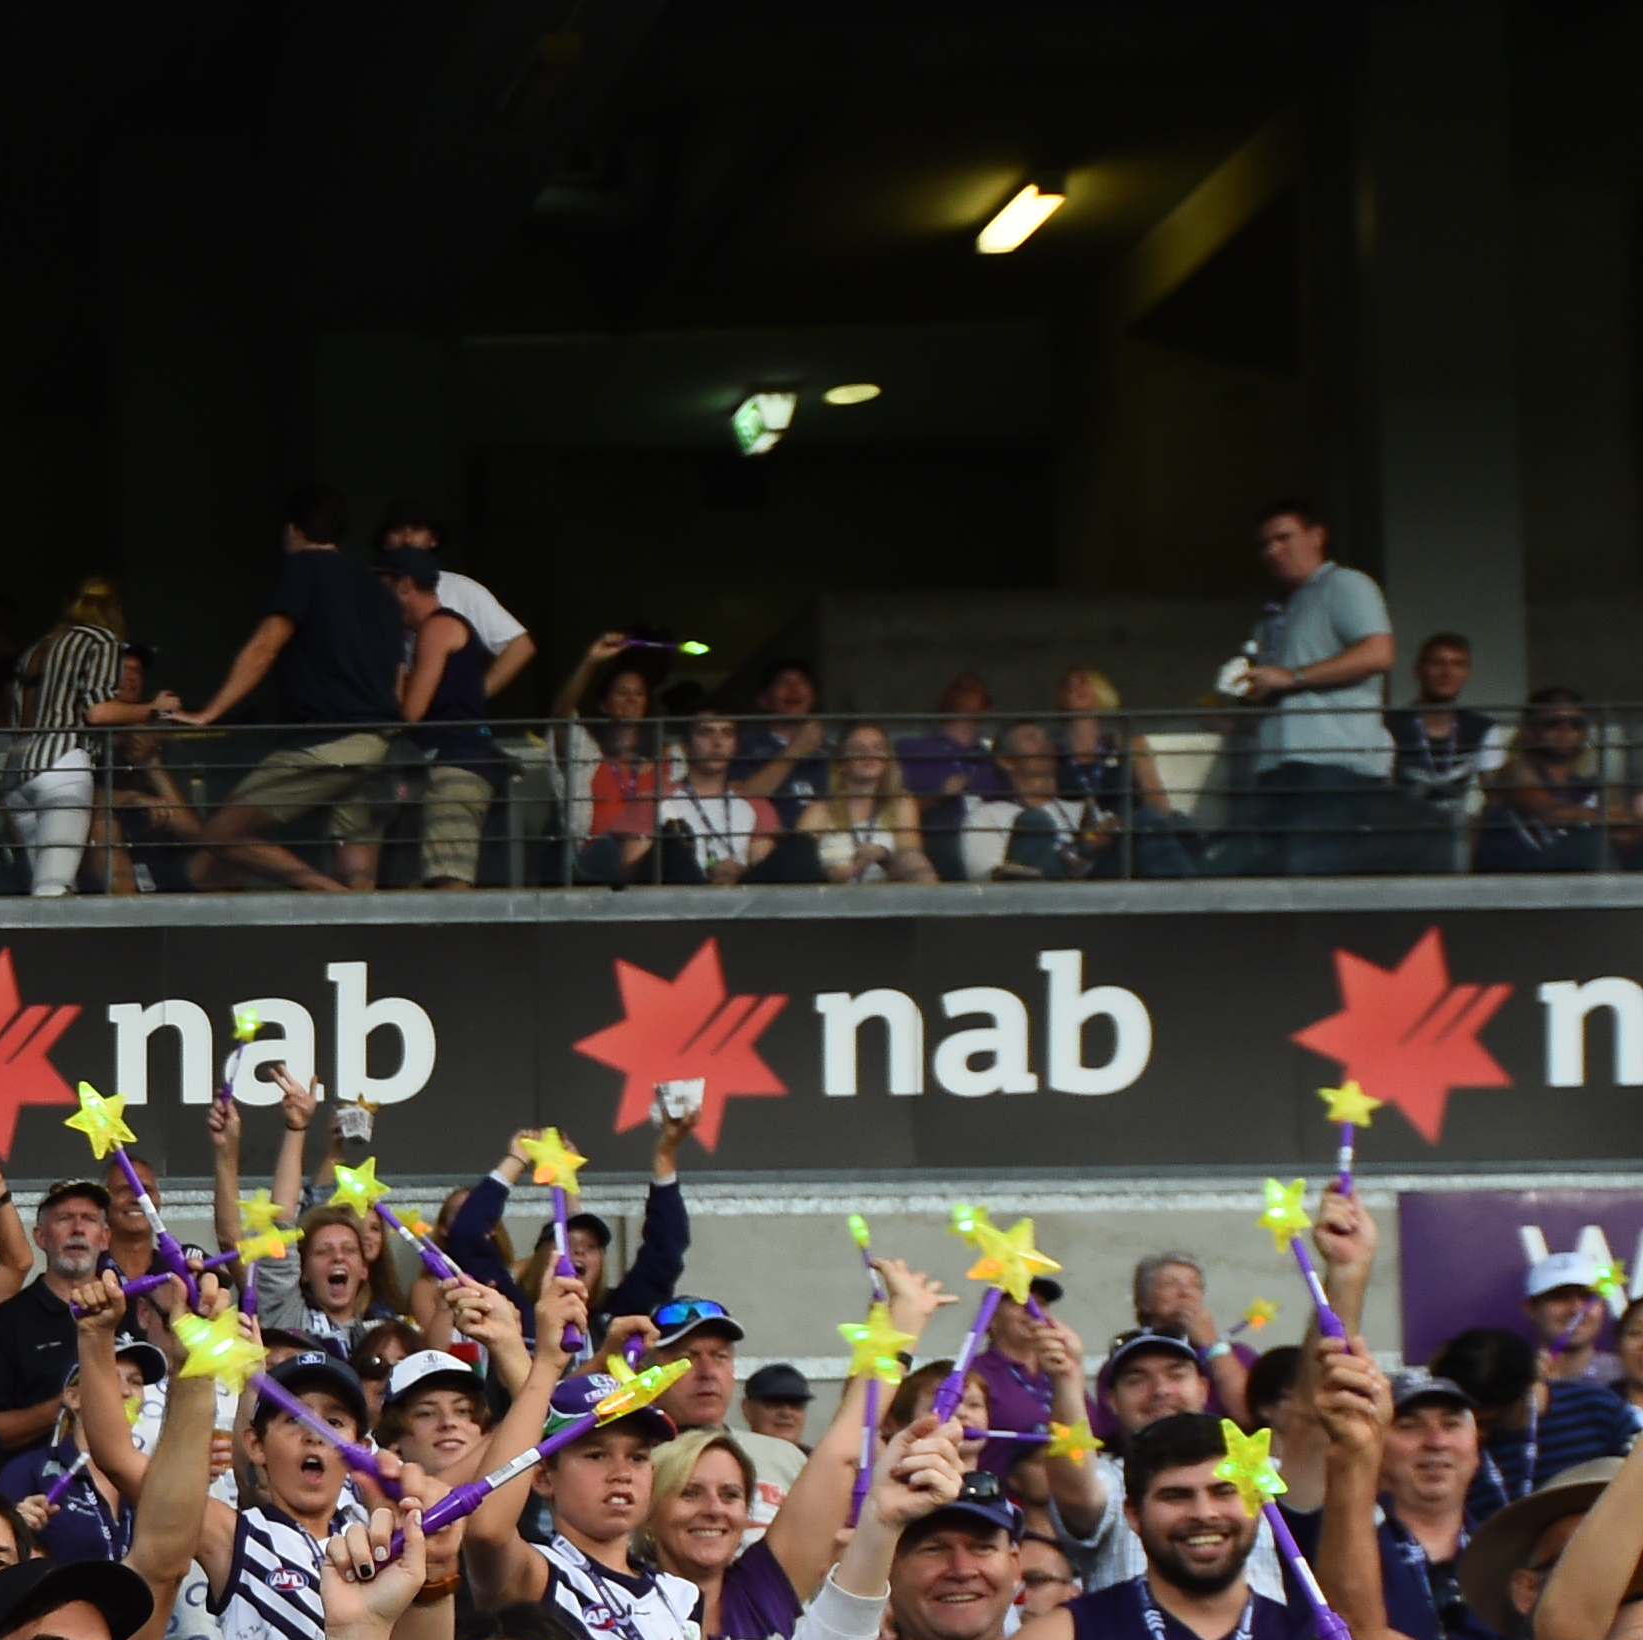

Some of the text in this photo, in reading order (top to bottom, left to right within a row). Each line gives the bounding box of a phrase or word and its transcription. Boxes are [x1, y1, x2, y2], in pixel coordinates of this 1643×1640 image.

[110, 961, 436, 1107] nab
[815, 949, 1152, 1099] nab
[270, 1570, 305, 1588] AFL
